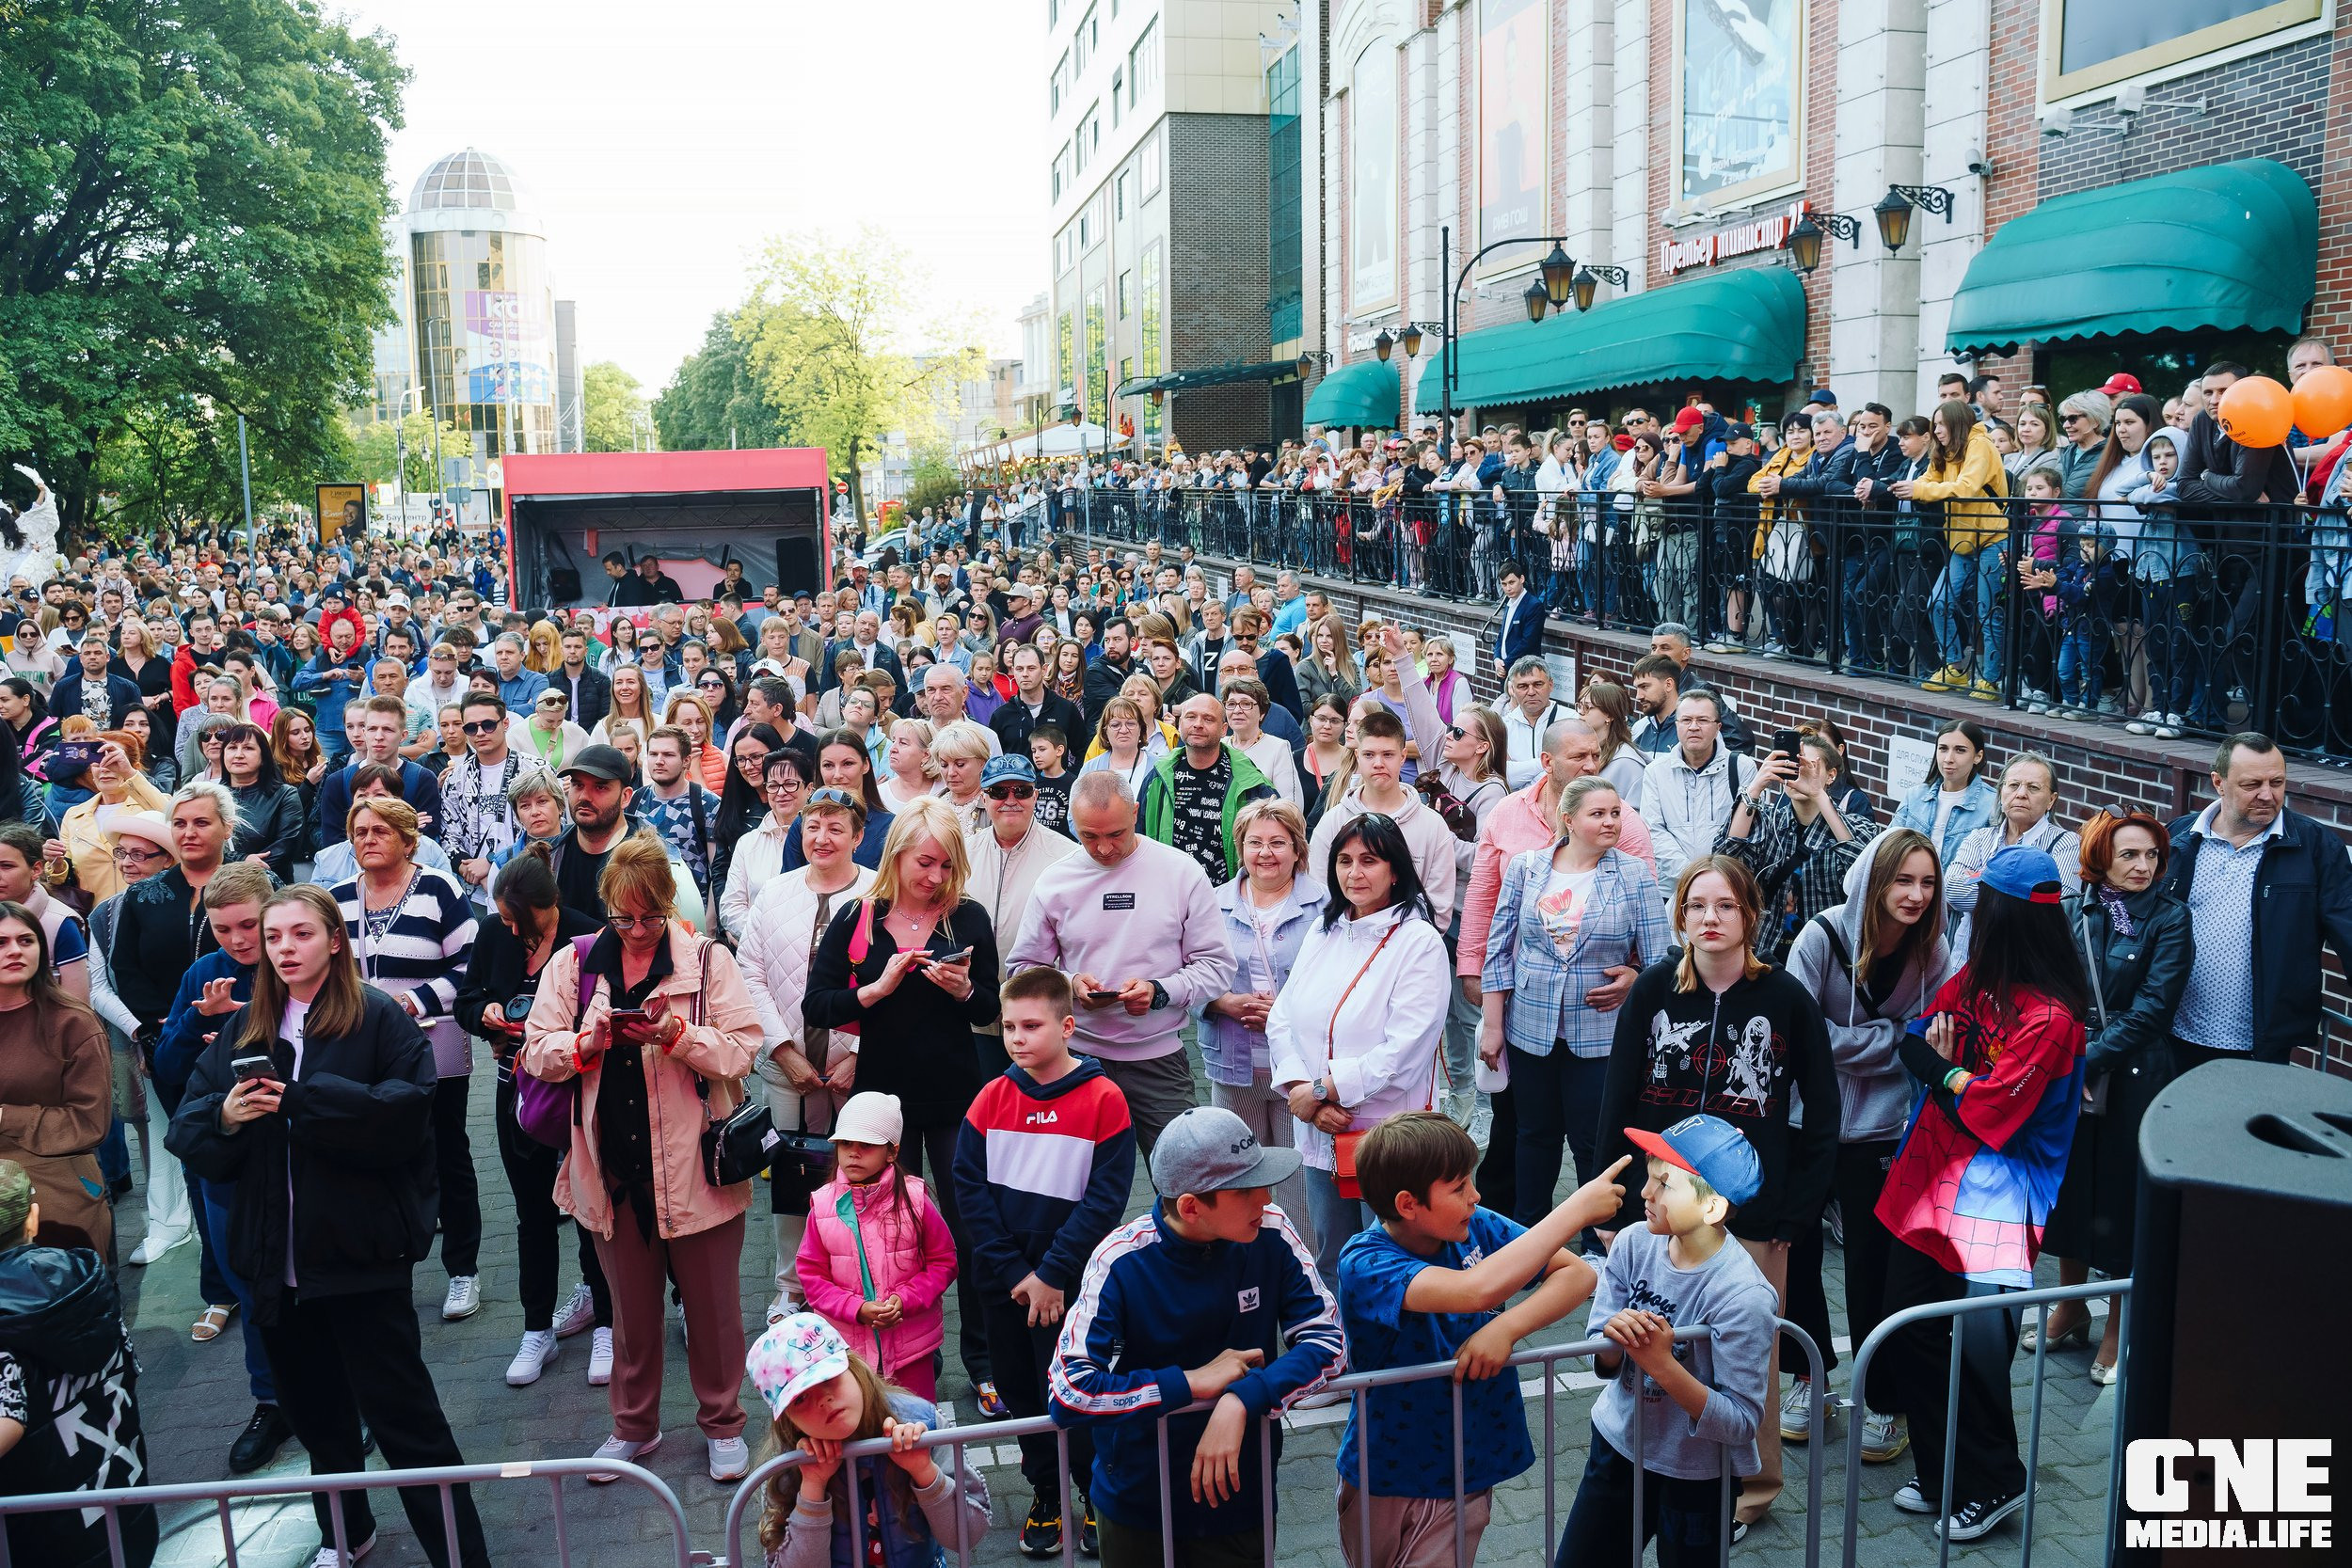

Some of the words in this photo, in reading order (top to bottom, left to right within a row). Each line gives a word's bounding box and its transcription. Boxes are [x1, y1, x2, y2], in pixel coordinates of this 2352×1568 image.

[1492, 212, 1510, 233] РИВ
[1510, 206, 1529, 228] ГОШ
[386, 514, 427, 523] Бауентр
[1203, 652, 1219, 671] Z
[1026, 1110, 1057, 1125] FILA
[1243, 1302, 1258, 1310] adidas
[1057, 1379, 1082, 1404] adidas
[1113, 1393, 1143, 1407] adidas
